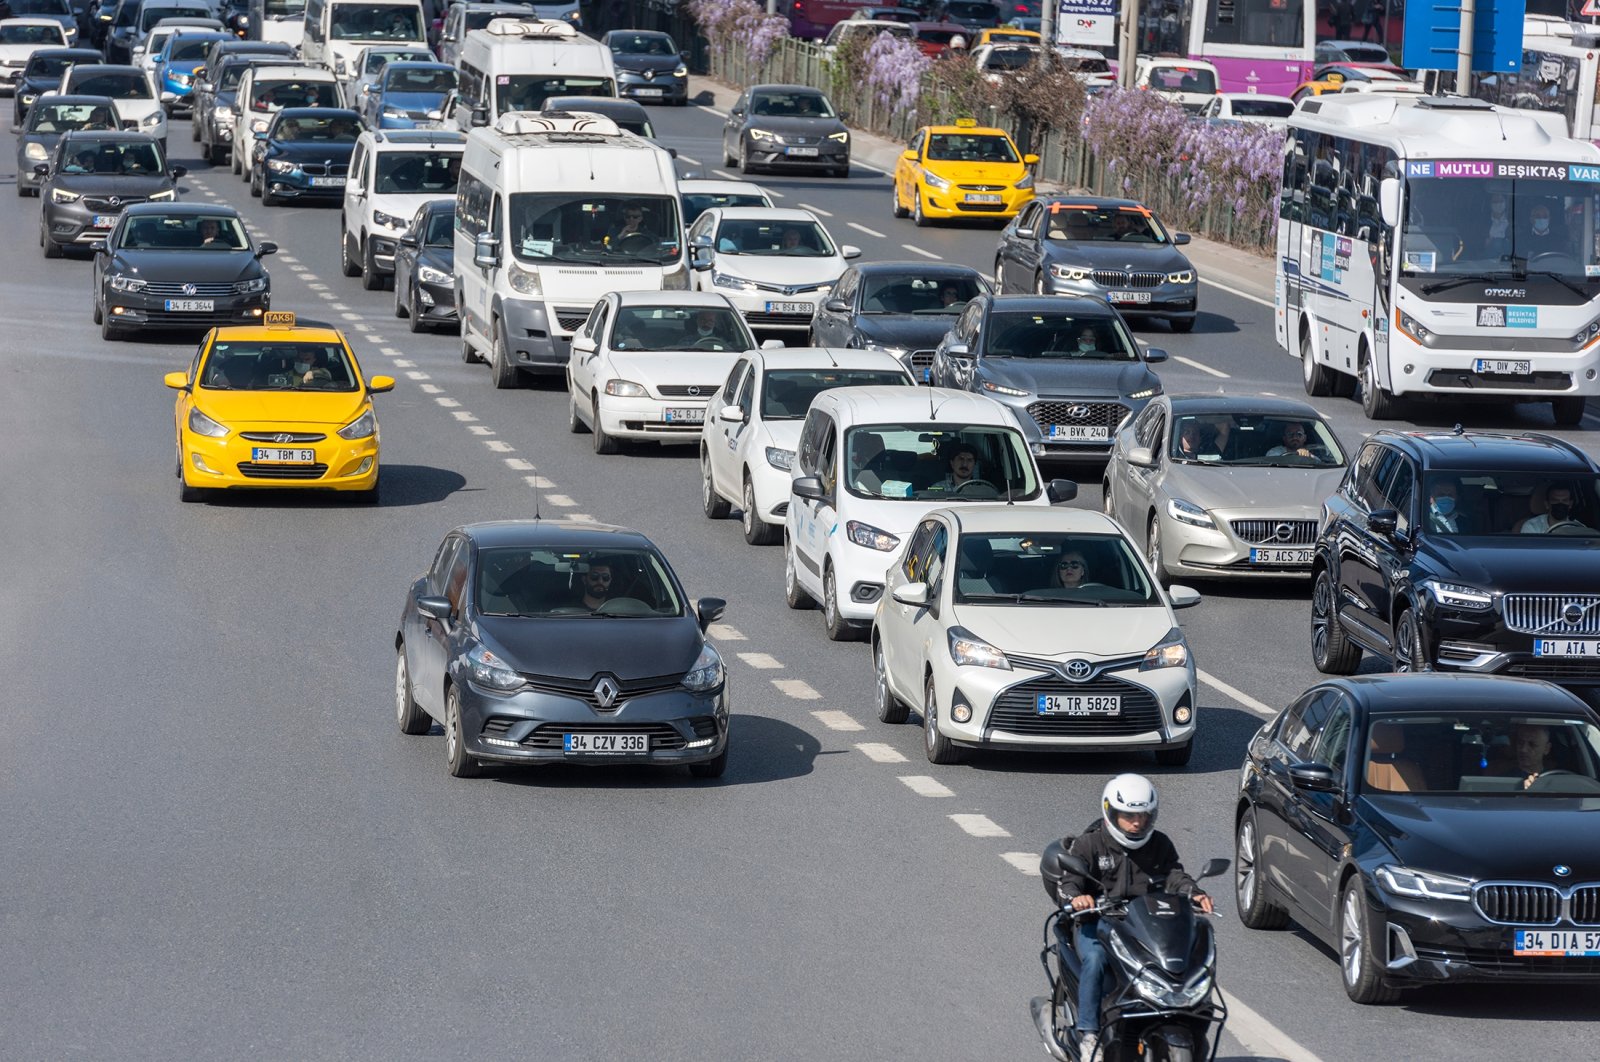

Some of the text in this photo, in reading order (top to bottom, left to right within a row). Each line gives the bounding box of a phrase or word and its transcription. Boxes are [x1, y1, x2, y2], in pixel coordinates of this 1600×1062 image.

[1410, 163, 1431, 175] NE
[1439, 163, 1491, 175] MUTLU
[1572, 167, 1600, 180] VAR
[1111, 291, 1120, 300] 34
[1484, 288, 1527, 298] OTOKAR
[171, 301, 212, 310] 34 FE 3644
[771, 303, 780, 311] 34
[1482, 361, 1492, 370] 34
[1514, 362, 1528, 371] 296
[672, 409, 682, 419] 34
[686, 409, 697, 419] BJ
[1056, 426, 1107, 438] 34 BVK 240
[258, 449, 313, 461] 34 TBM 63
[1257, 550, 1270, 561] 35
[1275, 550, 1294, 562] ACS
[1542, 641, 1555, 654] 01
[1566, 641, 1586, 655] ATA
[1046, 697, 1061, 711] 34
[1067, 697, 1082, 711] TR
[1087, 697, 1117, 711] 5829
[571, 735, 587, 750] 34
[593, 735, 617, 750] CZV
[620, 736, 644, 750] 336
[1525, 933, 1543, 949] 34
[1551, 933, 1579, 949] DIA
[1585, 933, 1600, 949] 57
